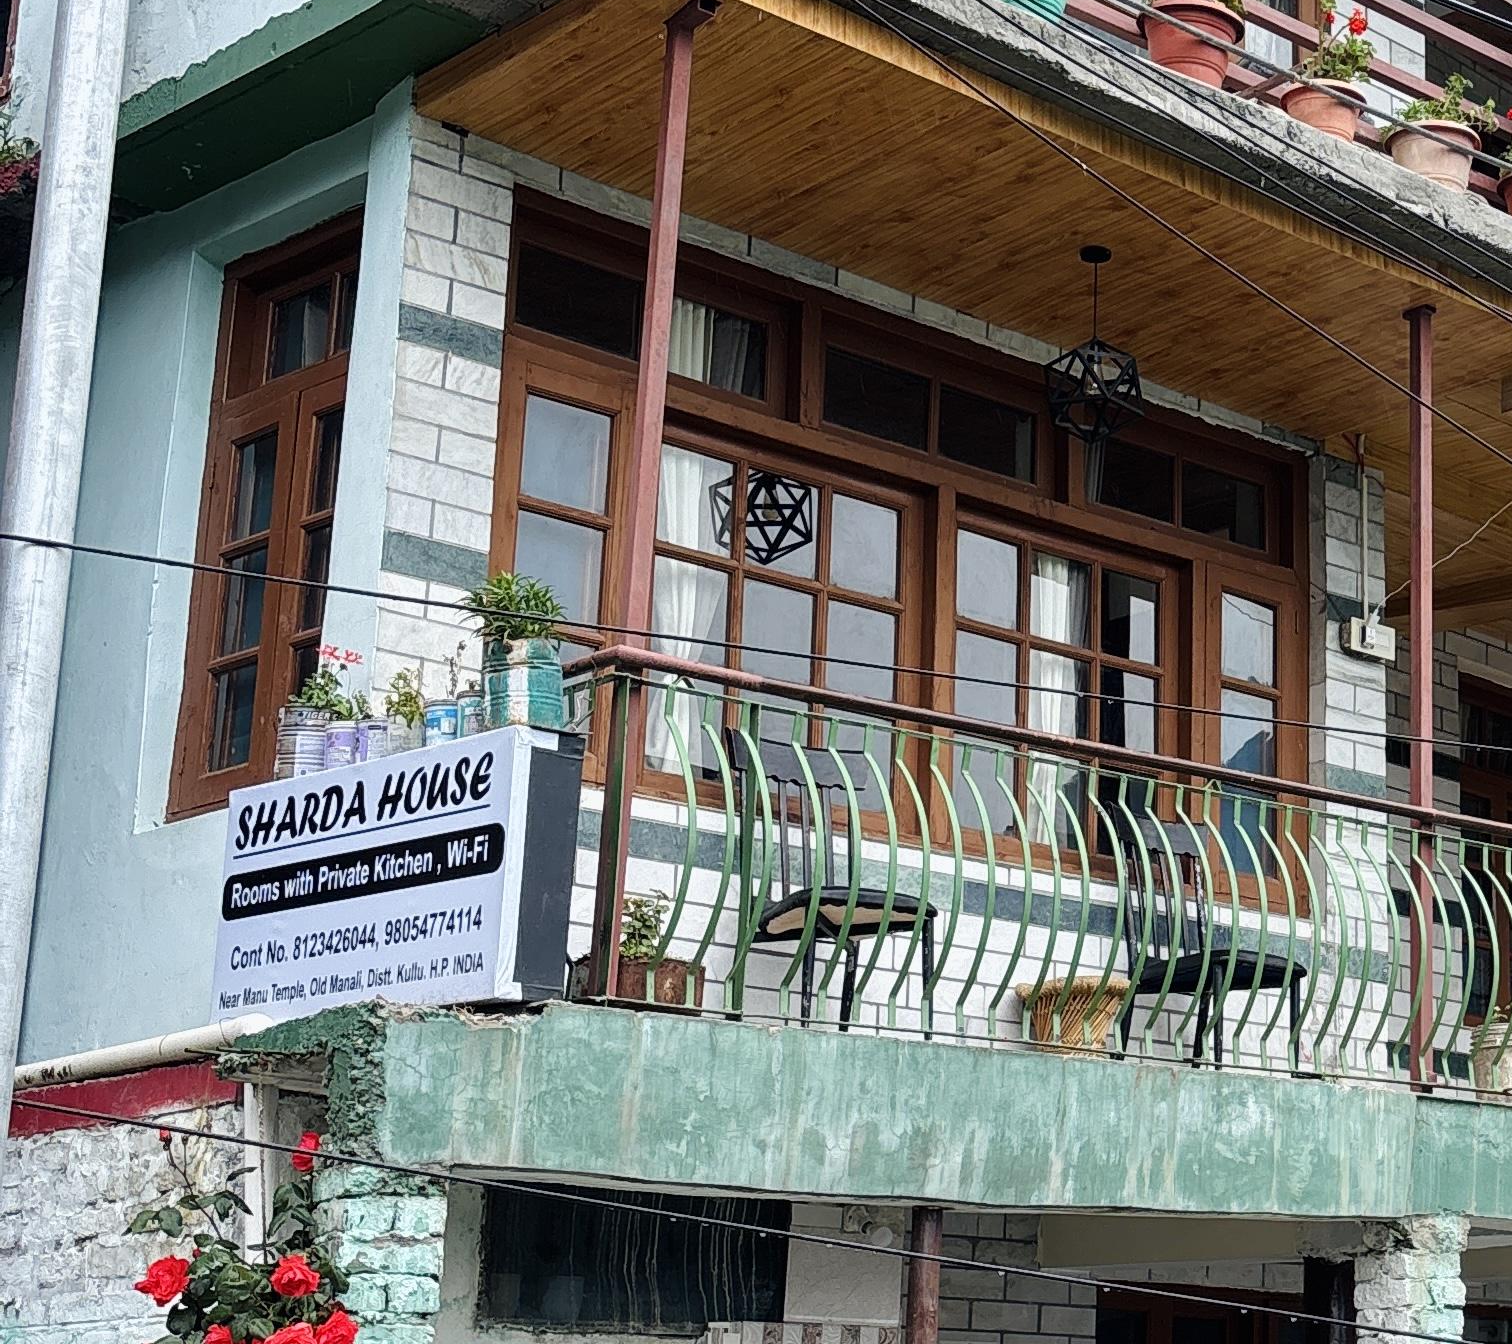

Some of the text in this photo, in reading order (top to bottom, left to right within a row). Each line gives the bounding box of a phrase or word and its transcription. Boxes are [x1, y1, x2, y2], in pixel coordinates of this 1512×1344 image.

[301, 711, 331, 720] TIGER
[234, 751, 495, 851] SHARDA HOUSE
[230, 881, 281, 909] Rooms
[283, 868, 314, 899] with
[317, 860, 370, 893] Private
[447, 834, 490, 869] Wi-Fi
[230, 903, 483, 971] Cont No. 8123426044, 98054774114
[218, 991, 242, 1010] Near
[242, 986, 269, 1007] Manu
[271, 979, 307, 1005] Temple,
[309, 975, 328, 997] Old
[328, 969, 365, 995] Manali,
[429, 957, 450, 980] H.P.
[452, 951, 484, 976] INDIA
